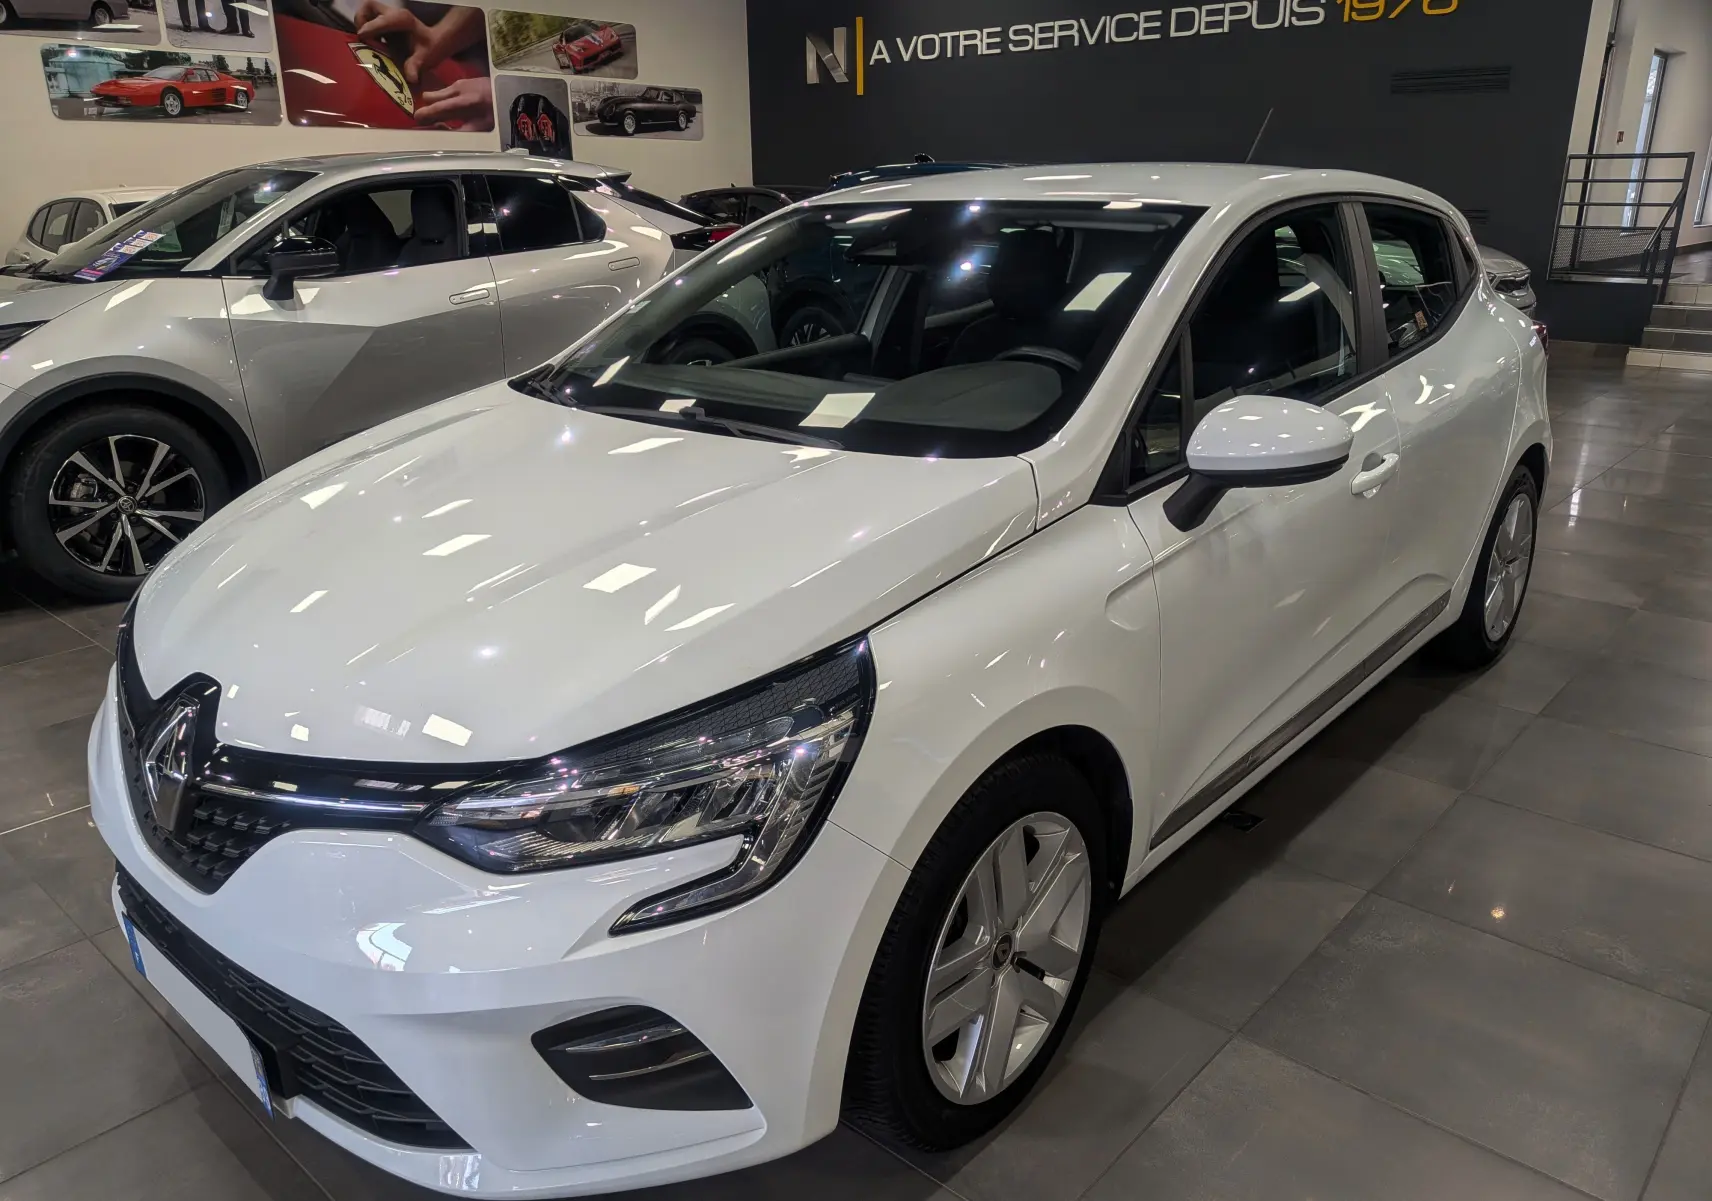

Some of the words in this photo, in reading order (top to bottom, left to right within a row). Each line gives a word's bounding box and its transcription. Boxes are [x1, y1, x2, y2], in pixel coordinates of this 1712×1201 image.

[869, 39, 892, 66] A
[896, 26, 1003, 62] VOTRE
[1008, 9, 1163, 52] SERVICE
[1169, 0, 1326, 38] DEPUIS
